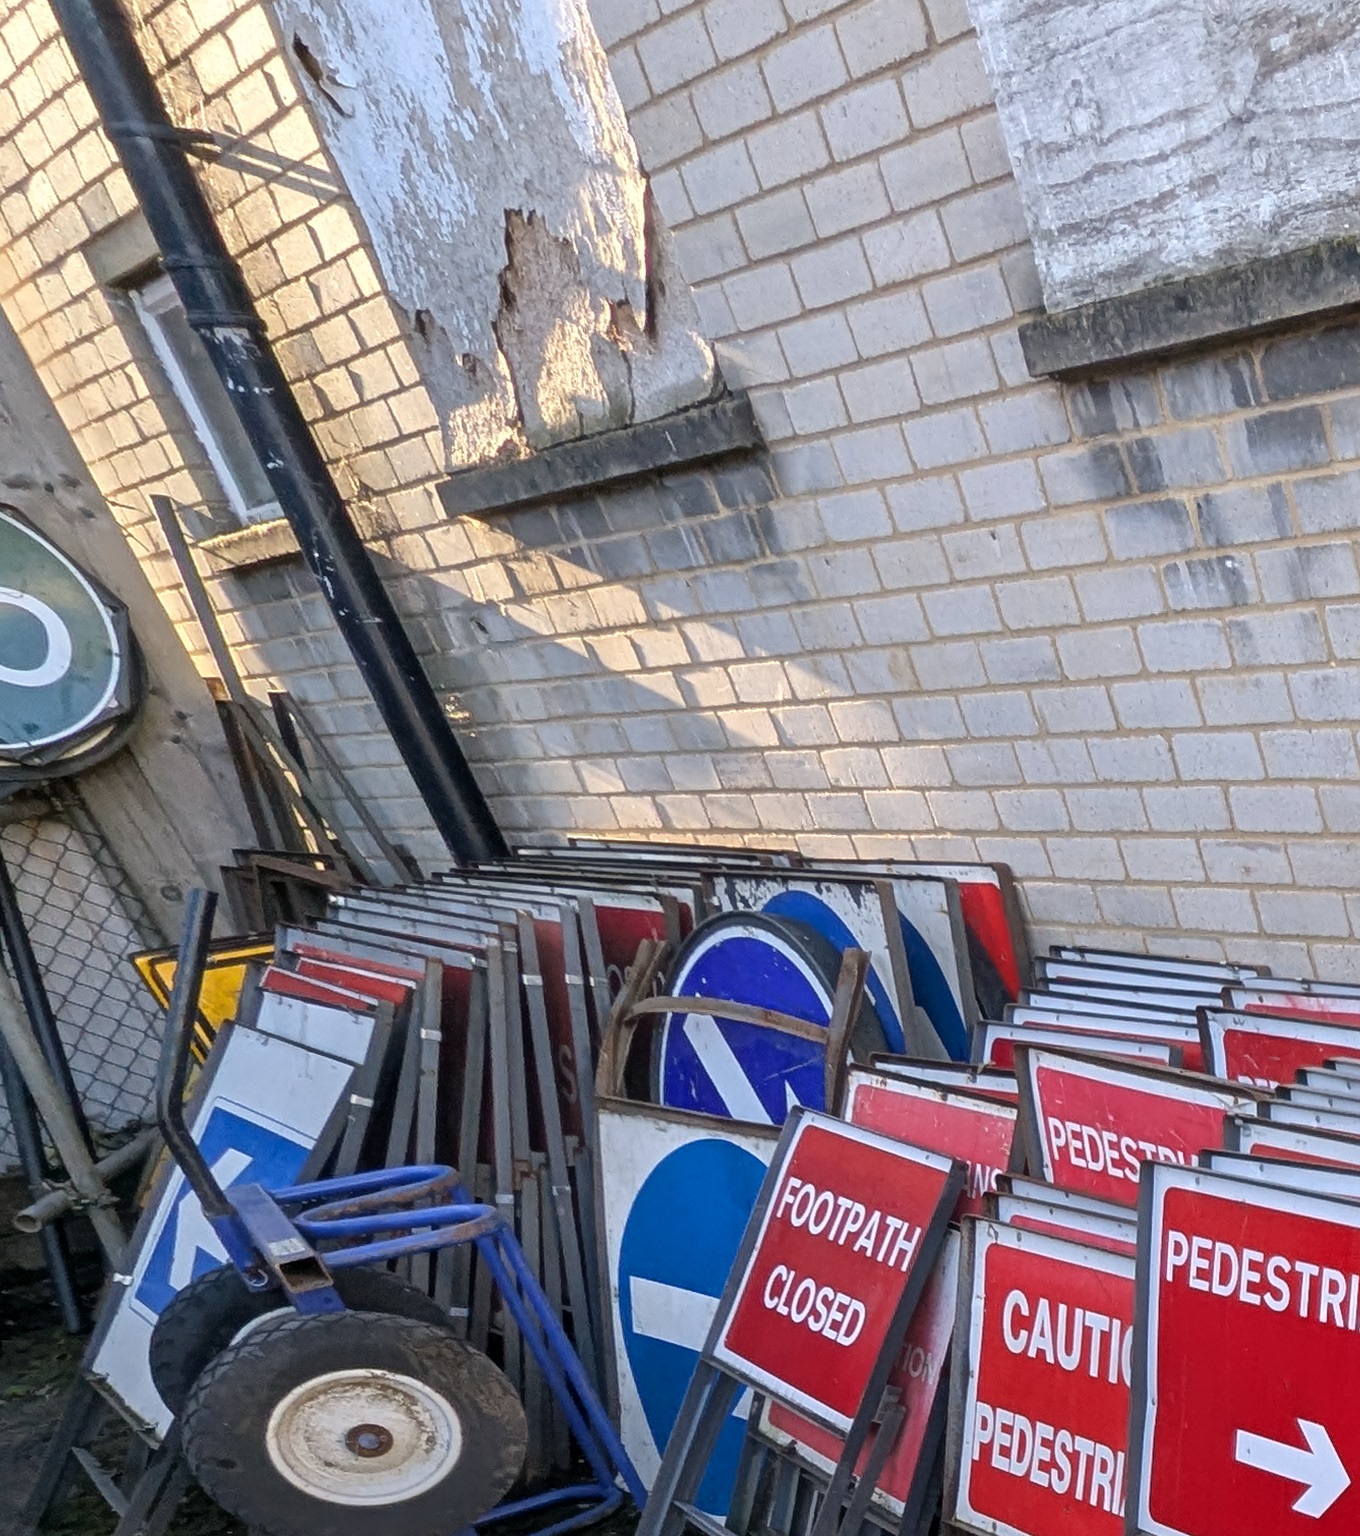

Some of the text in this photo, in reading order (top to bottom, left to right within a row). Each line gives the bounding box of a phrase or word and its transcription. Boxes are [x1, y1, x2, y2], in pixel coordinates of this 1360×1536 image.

[776, 1176, 922, 1272] FOOTPATH
[764, 1265, 866, 1346] CLOSED
[972, 1400, 1126, 1517] PEDESTRI
